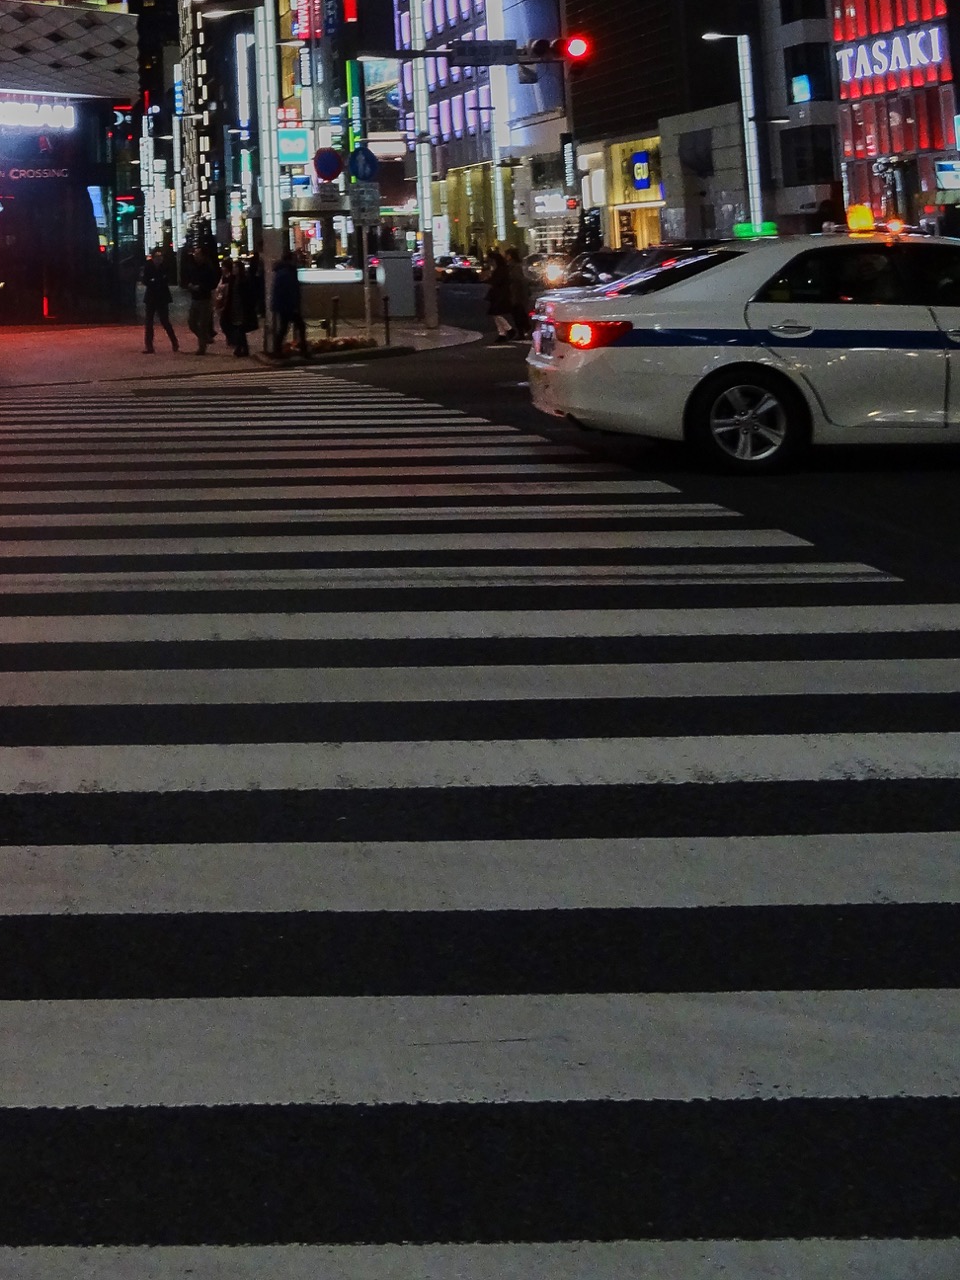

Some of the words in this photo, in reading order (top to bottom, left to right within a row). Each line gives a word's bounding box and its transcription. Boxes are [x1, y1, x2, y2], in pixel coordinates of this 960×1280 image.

[836, 27, 942, 82] TASAKI
[8, 167, 69, 180] CROSSING
[633, 162, 649, 181] GU
